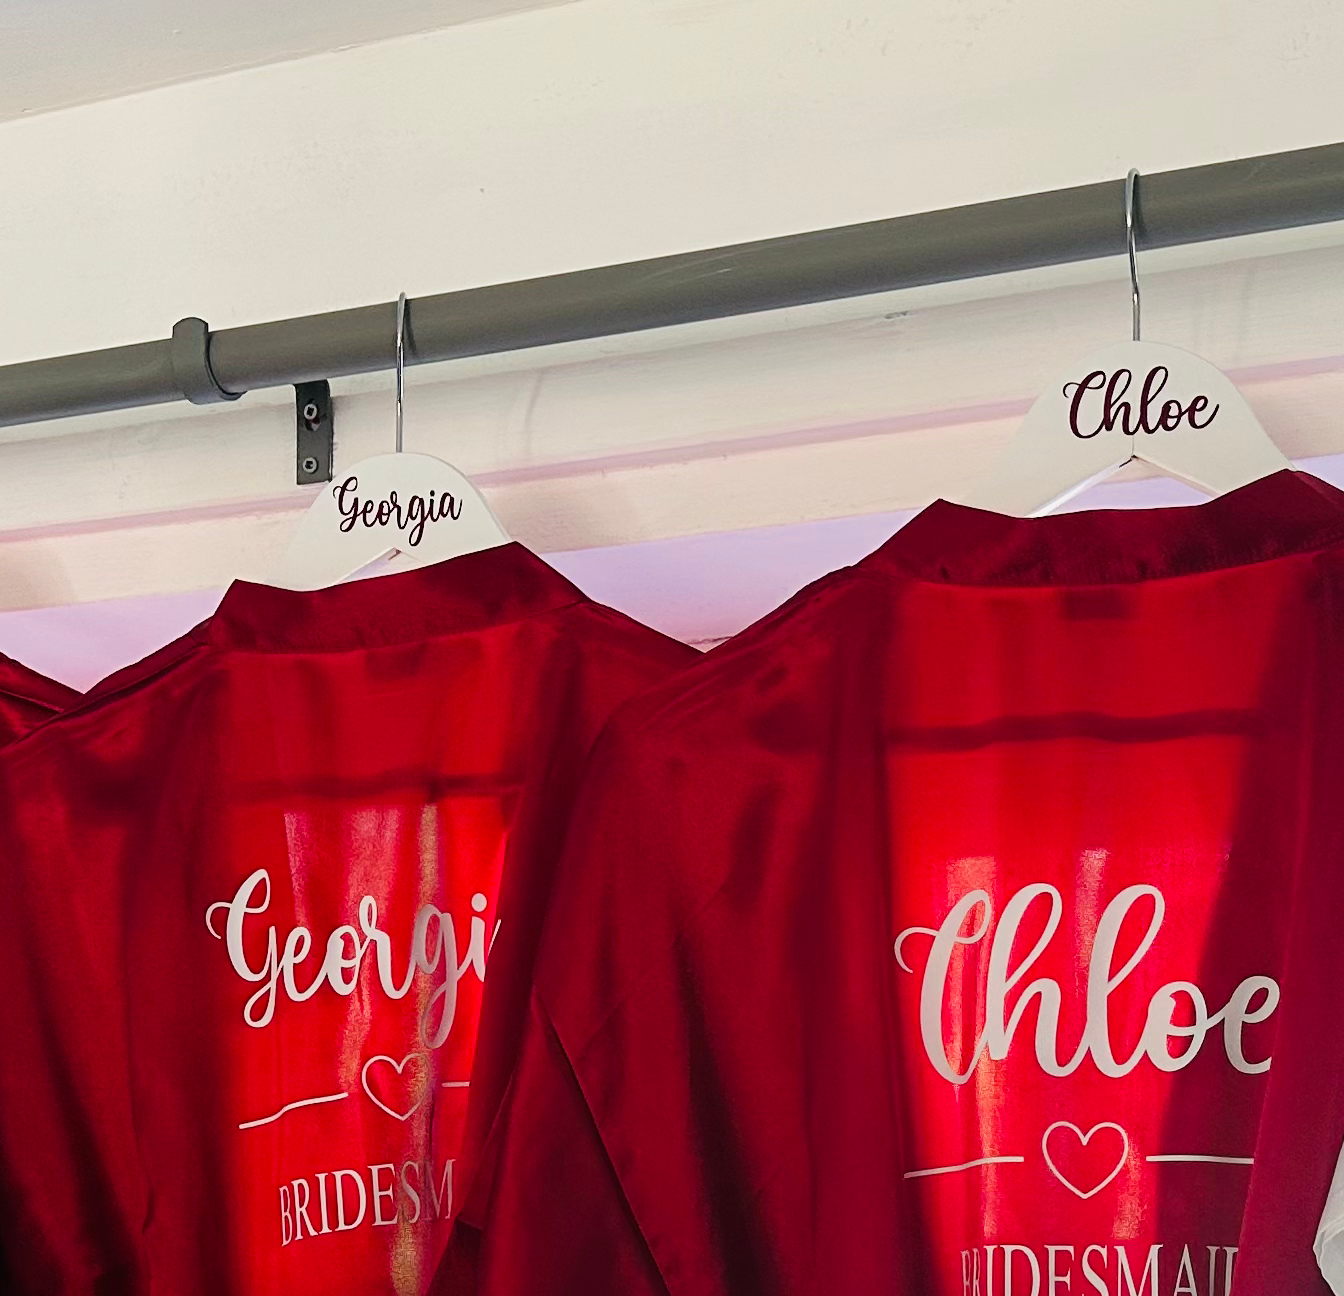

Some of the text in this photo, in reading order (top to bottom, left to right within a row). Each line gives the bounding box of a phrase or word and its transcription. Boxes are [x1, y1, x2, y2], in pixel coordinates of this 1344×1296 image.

[1063, 366, 1219, 439] Chloe
[333, 477, 462, 547] Georgia
[205, 868, 501, 1049] Georgi
[894, 883, 1280, 1084] Chloe
[279, 1158, 456, 1247] BRIDESM
